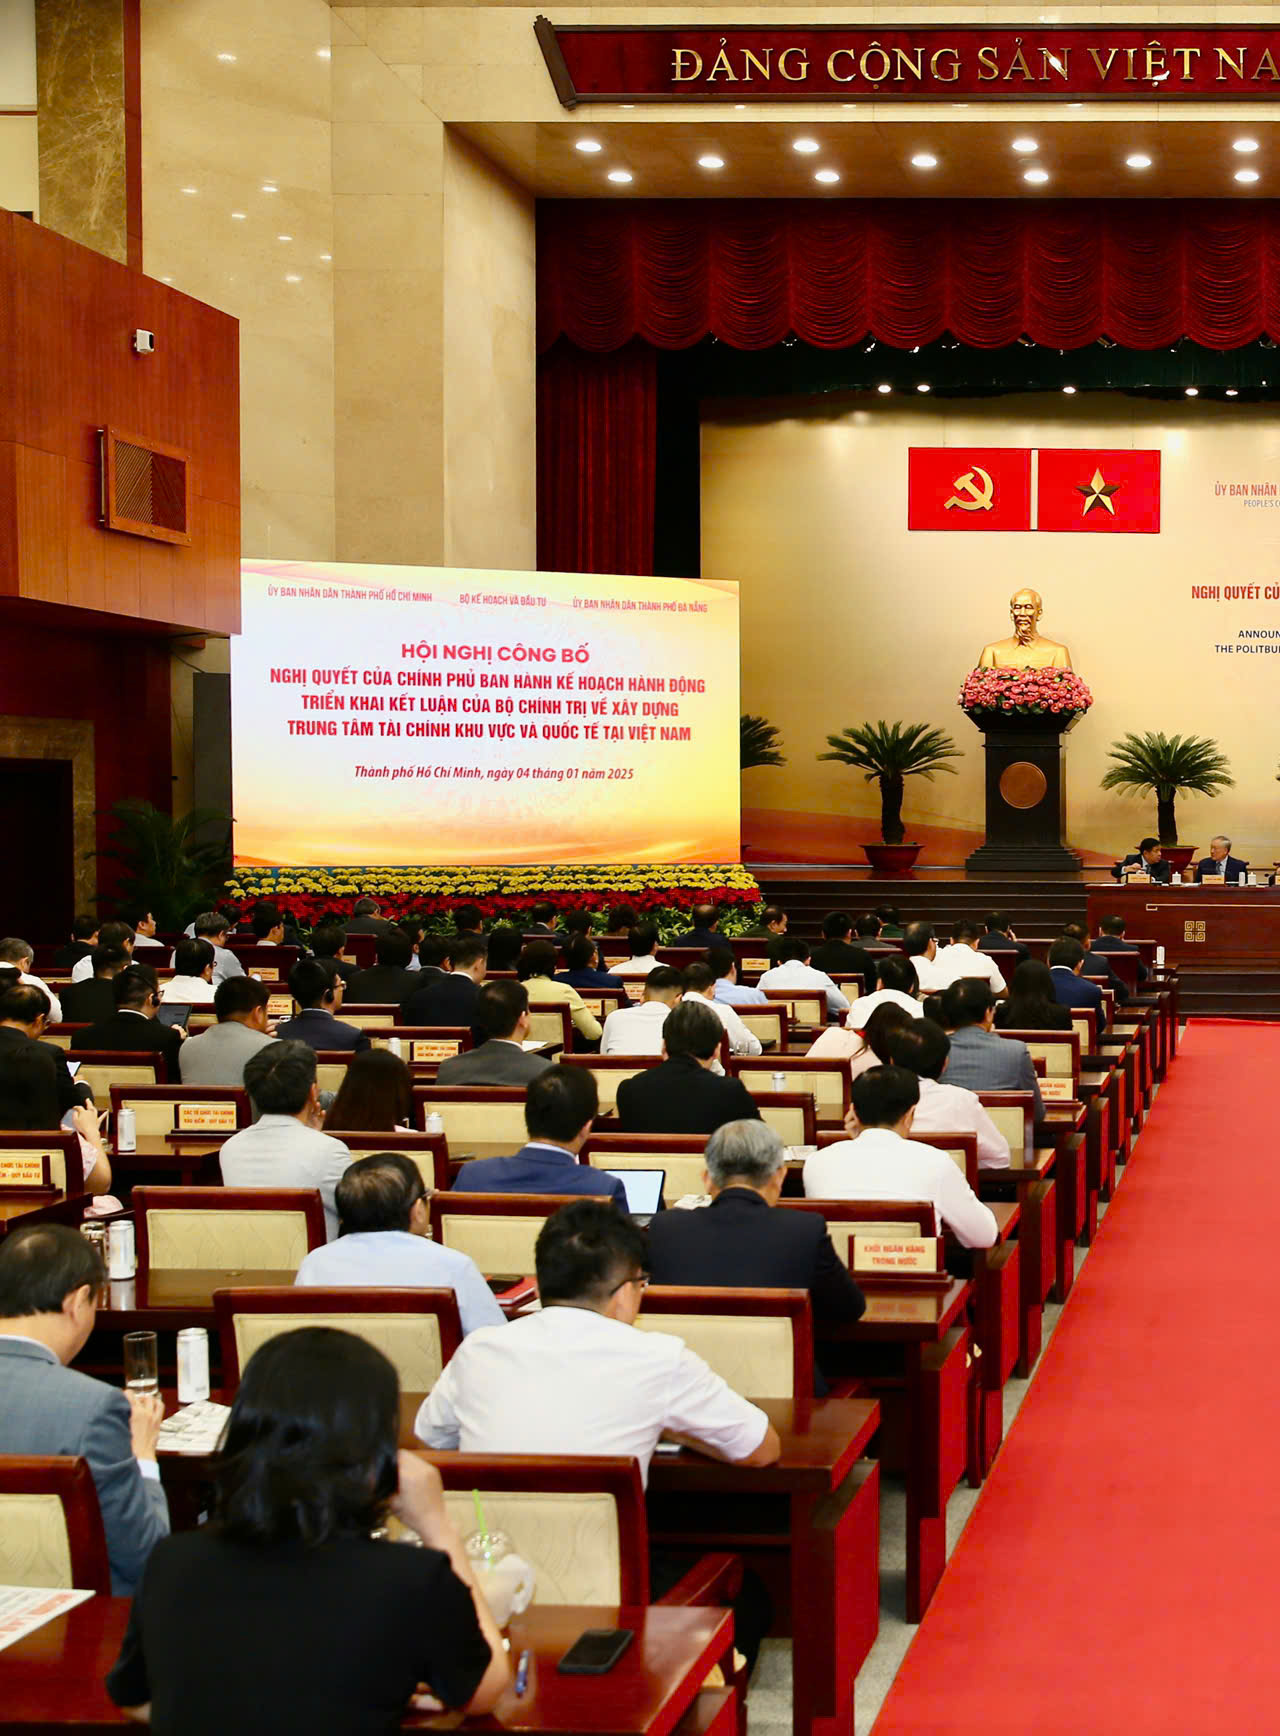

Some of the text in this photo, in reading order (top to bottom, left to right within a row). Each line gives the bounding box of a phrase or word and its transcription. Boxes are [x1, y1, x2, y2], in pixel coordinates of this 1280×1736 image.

[672, 38, 809, 82] ĐẢNG
[827, 41, 961, 89] CỘNG
[978, 38, 1072, 81] SẢN
[1087, 40, 1200, 88] VIỆT
[1215, 481, 1226, 496] ỦY
[1230, 484, 1248, 496] BAN
[1251, 482, 1276, 496] NHÂN
[1192, 586, 1220, 602] NGHỊ
[1224, 583, 1260, 600] QUYẾT
[402, 640, 589, 664] HỘI NGHỊ CÔNG BỐ
[271, 666, 704, 695] NGHỊ QUYẾT CỦA CHÍNH PHỦ BAN HÀNH KẾ HOẠCH HÀNH ĐỘNG
